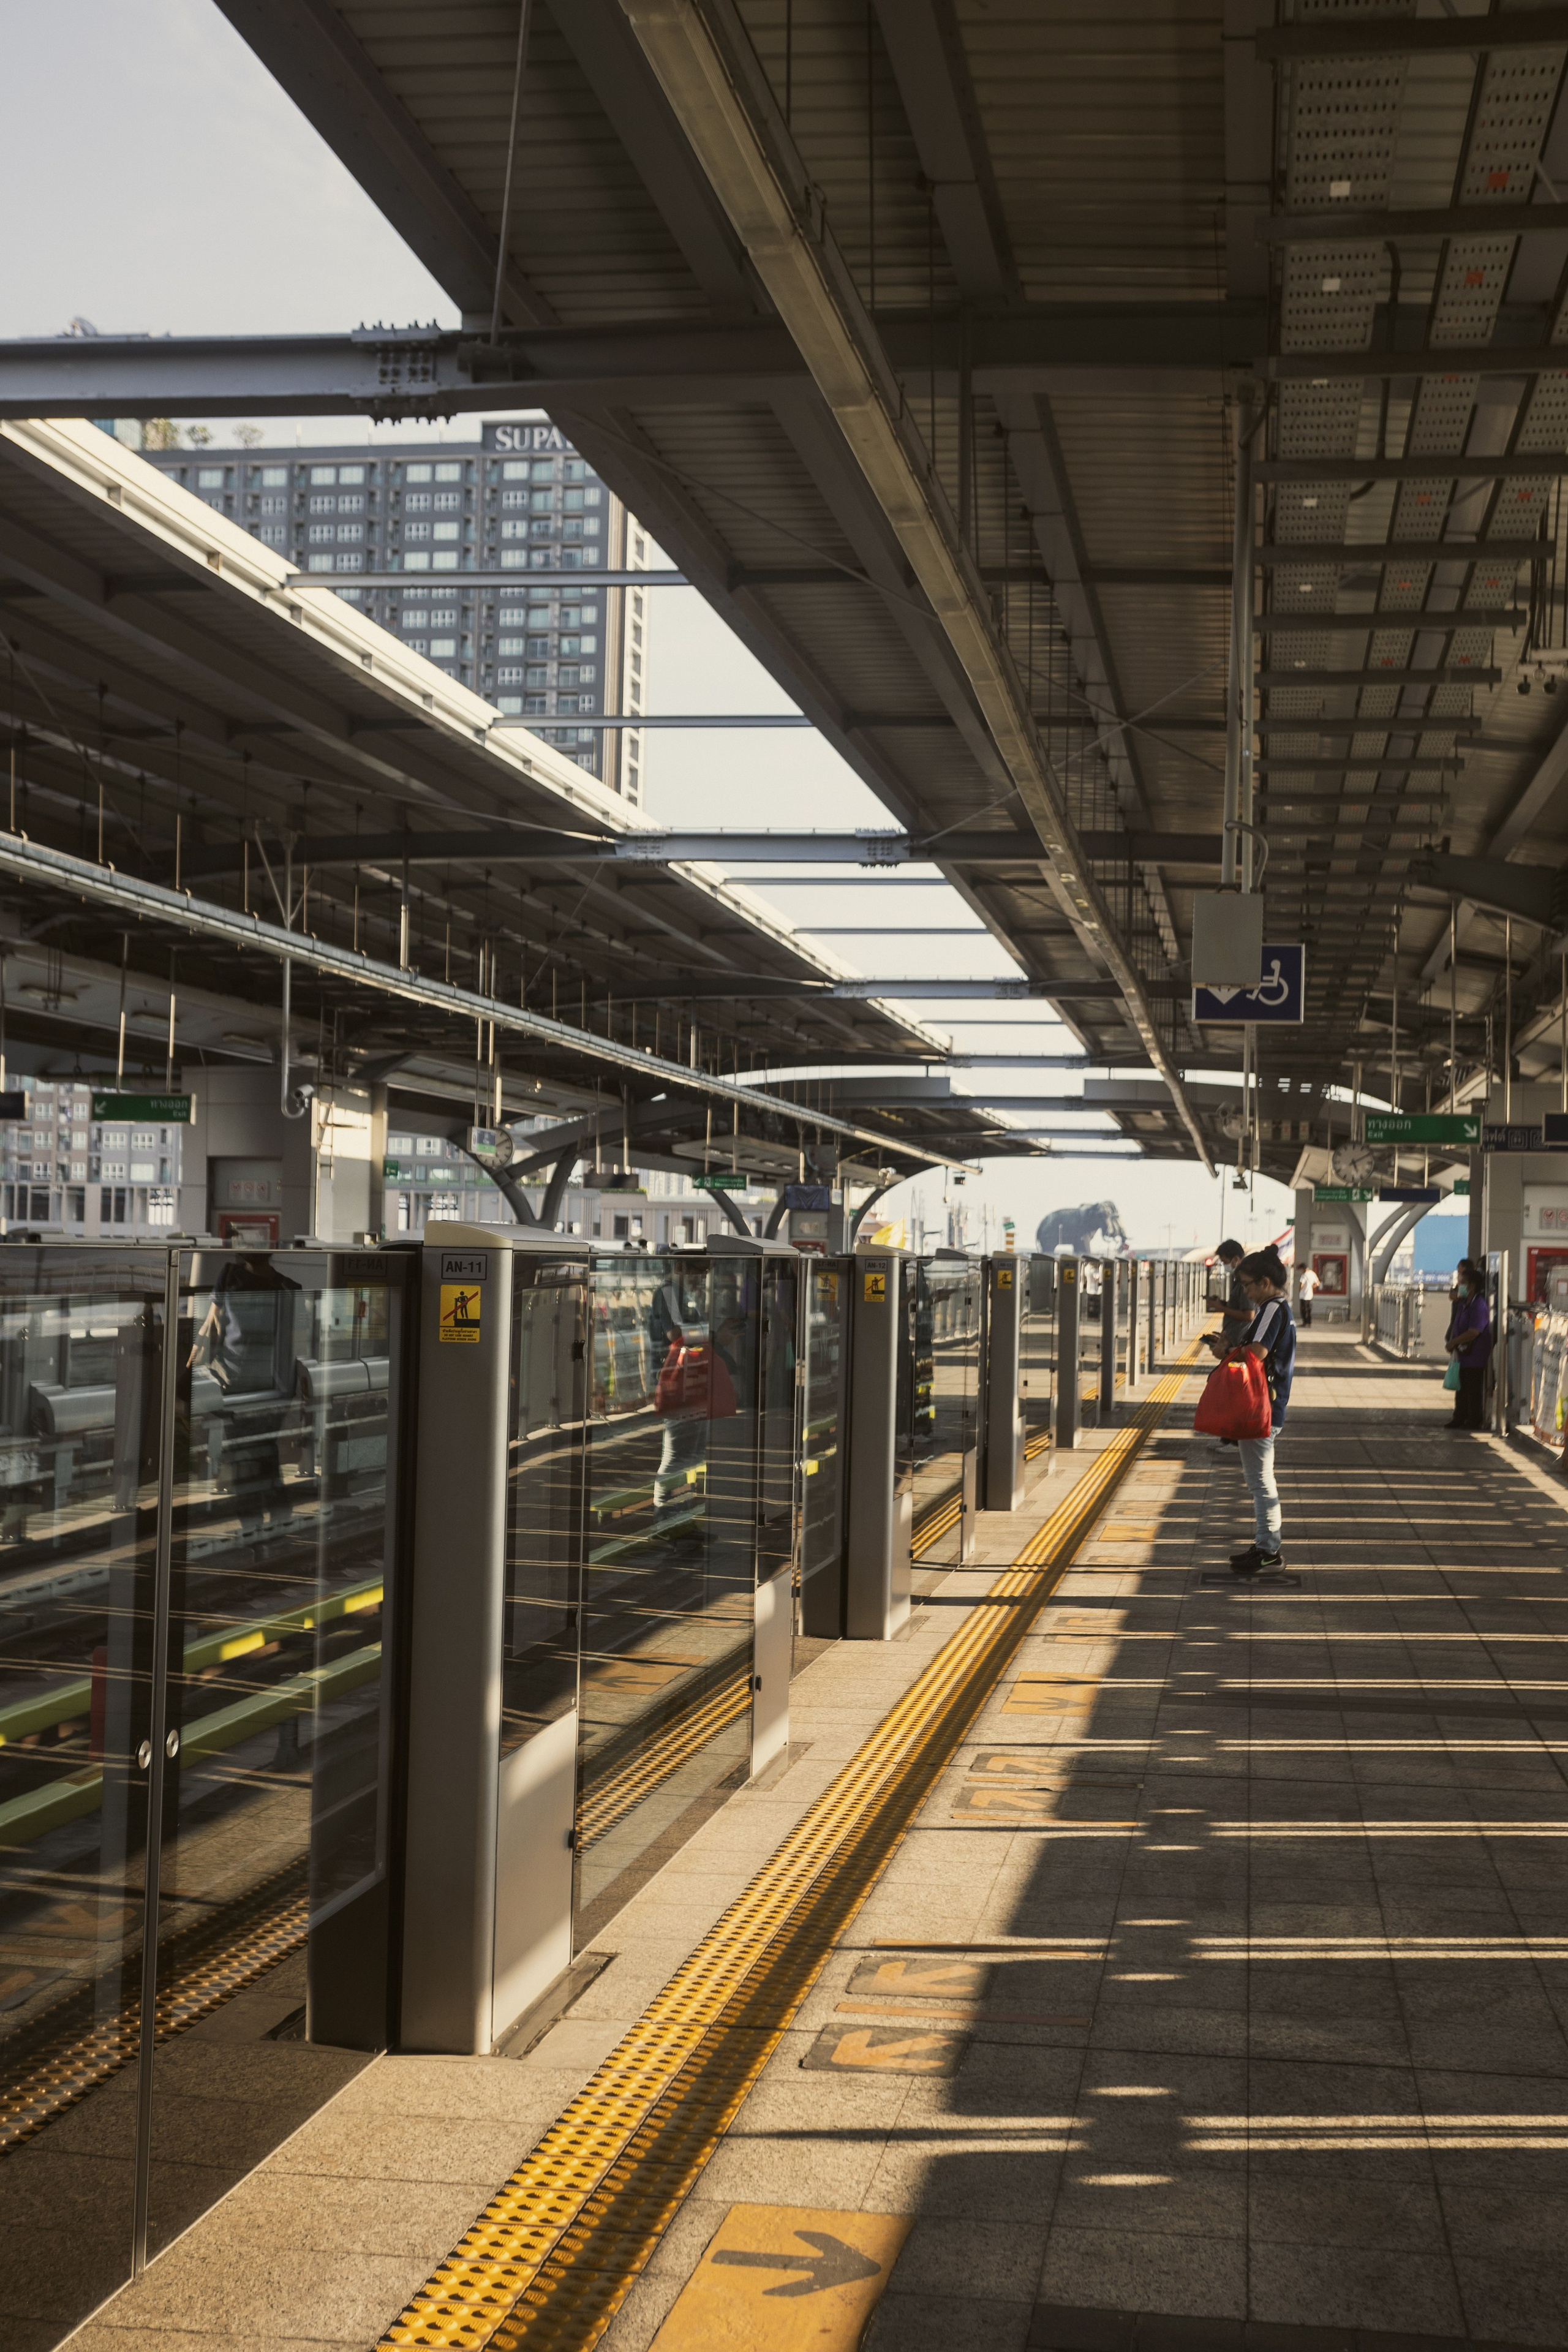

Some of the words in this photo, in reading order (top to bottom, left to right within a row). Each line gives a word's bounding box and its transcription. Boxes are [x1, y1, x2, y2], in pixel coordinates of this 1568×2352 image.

[150, 1099, 188, 1109] ทางออก
[1367, 1118, 1412, 1130] ทางออก
[1367, 1131, 1384, 1139] Exit
[445, 1261, 482, 1273] AN-11
